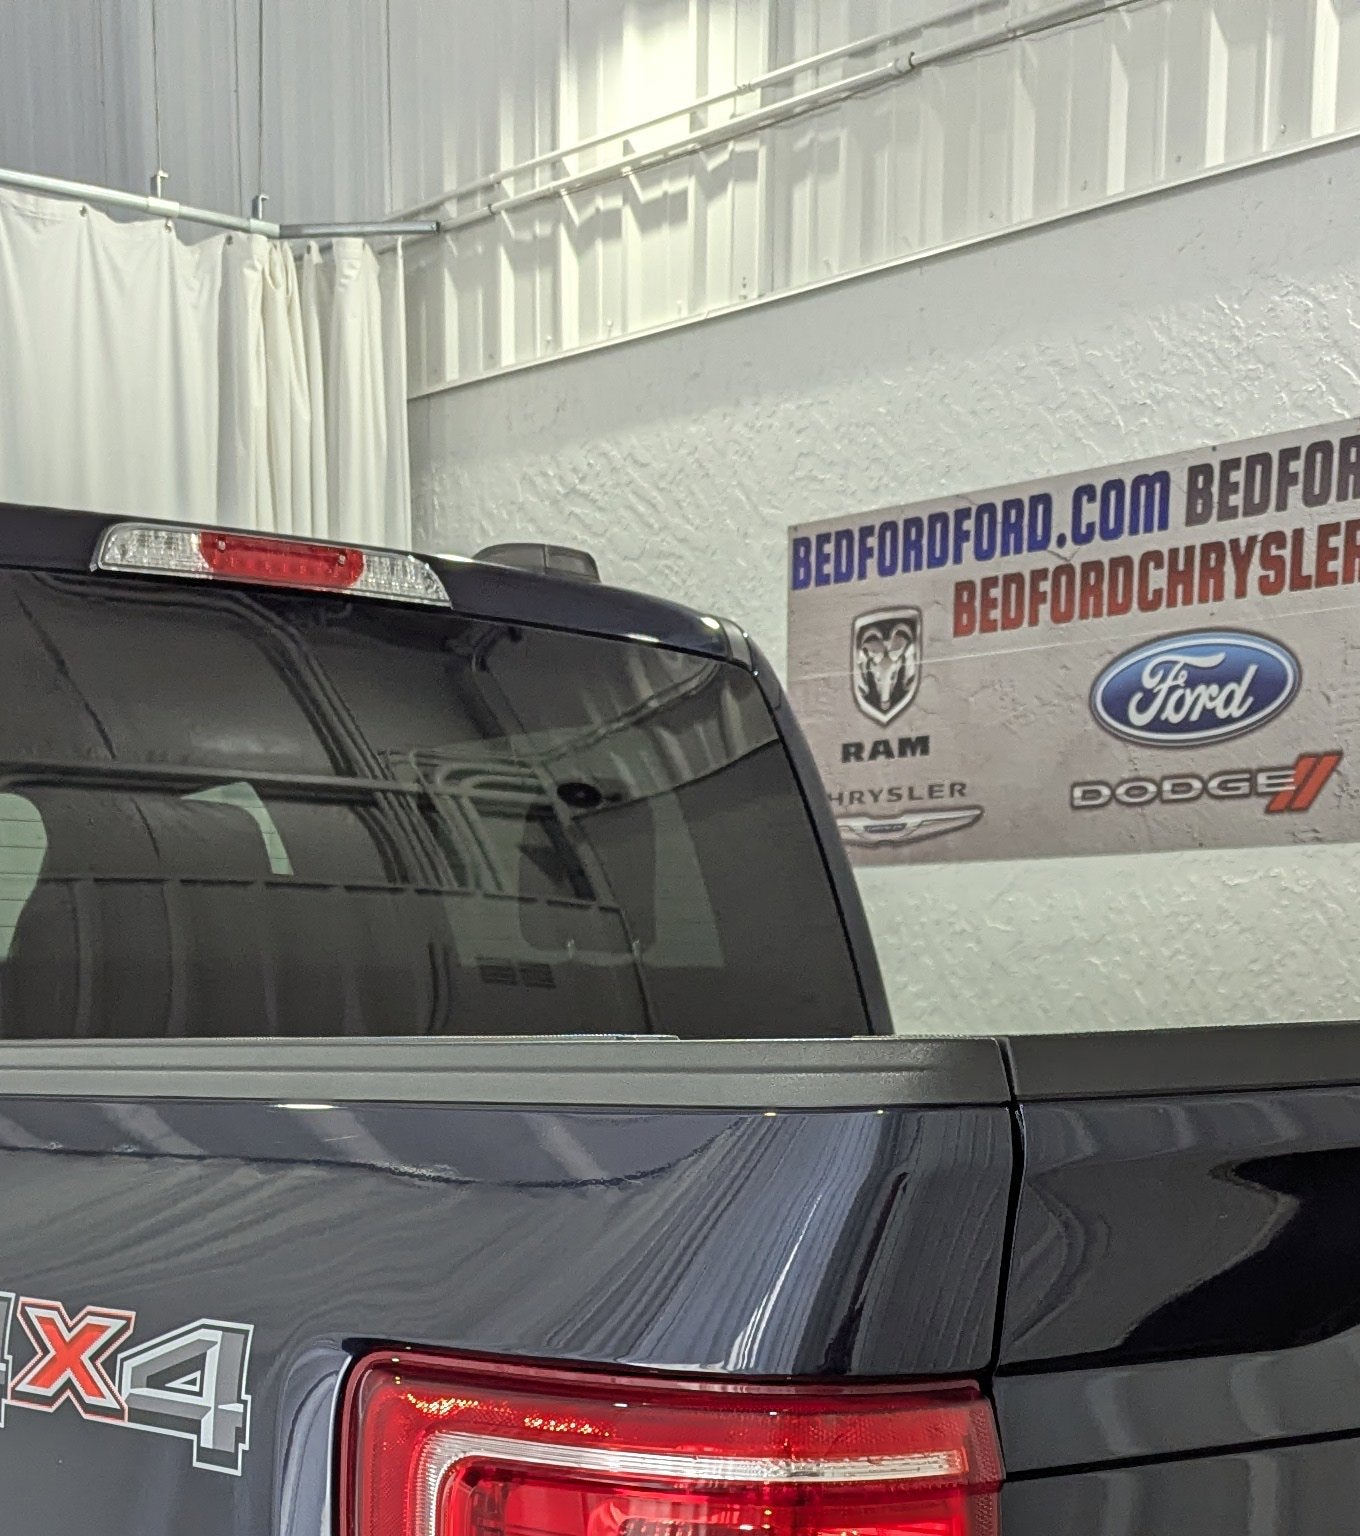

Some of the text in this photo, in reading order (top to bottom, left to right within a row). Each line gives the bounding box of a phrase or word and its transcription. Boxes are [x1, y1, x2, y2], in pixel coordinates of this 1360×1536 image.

[791, 470, 1171, 591] BEDFORDFORD.COM
[1127, 651, 1259, 727] Ford
[841, 735, 931, 764] RAM
[827, 782, 968, 806] HRYSLER
[1070, 765, 1297, 811] DODGE
